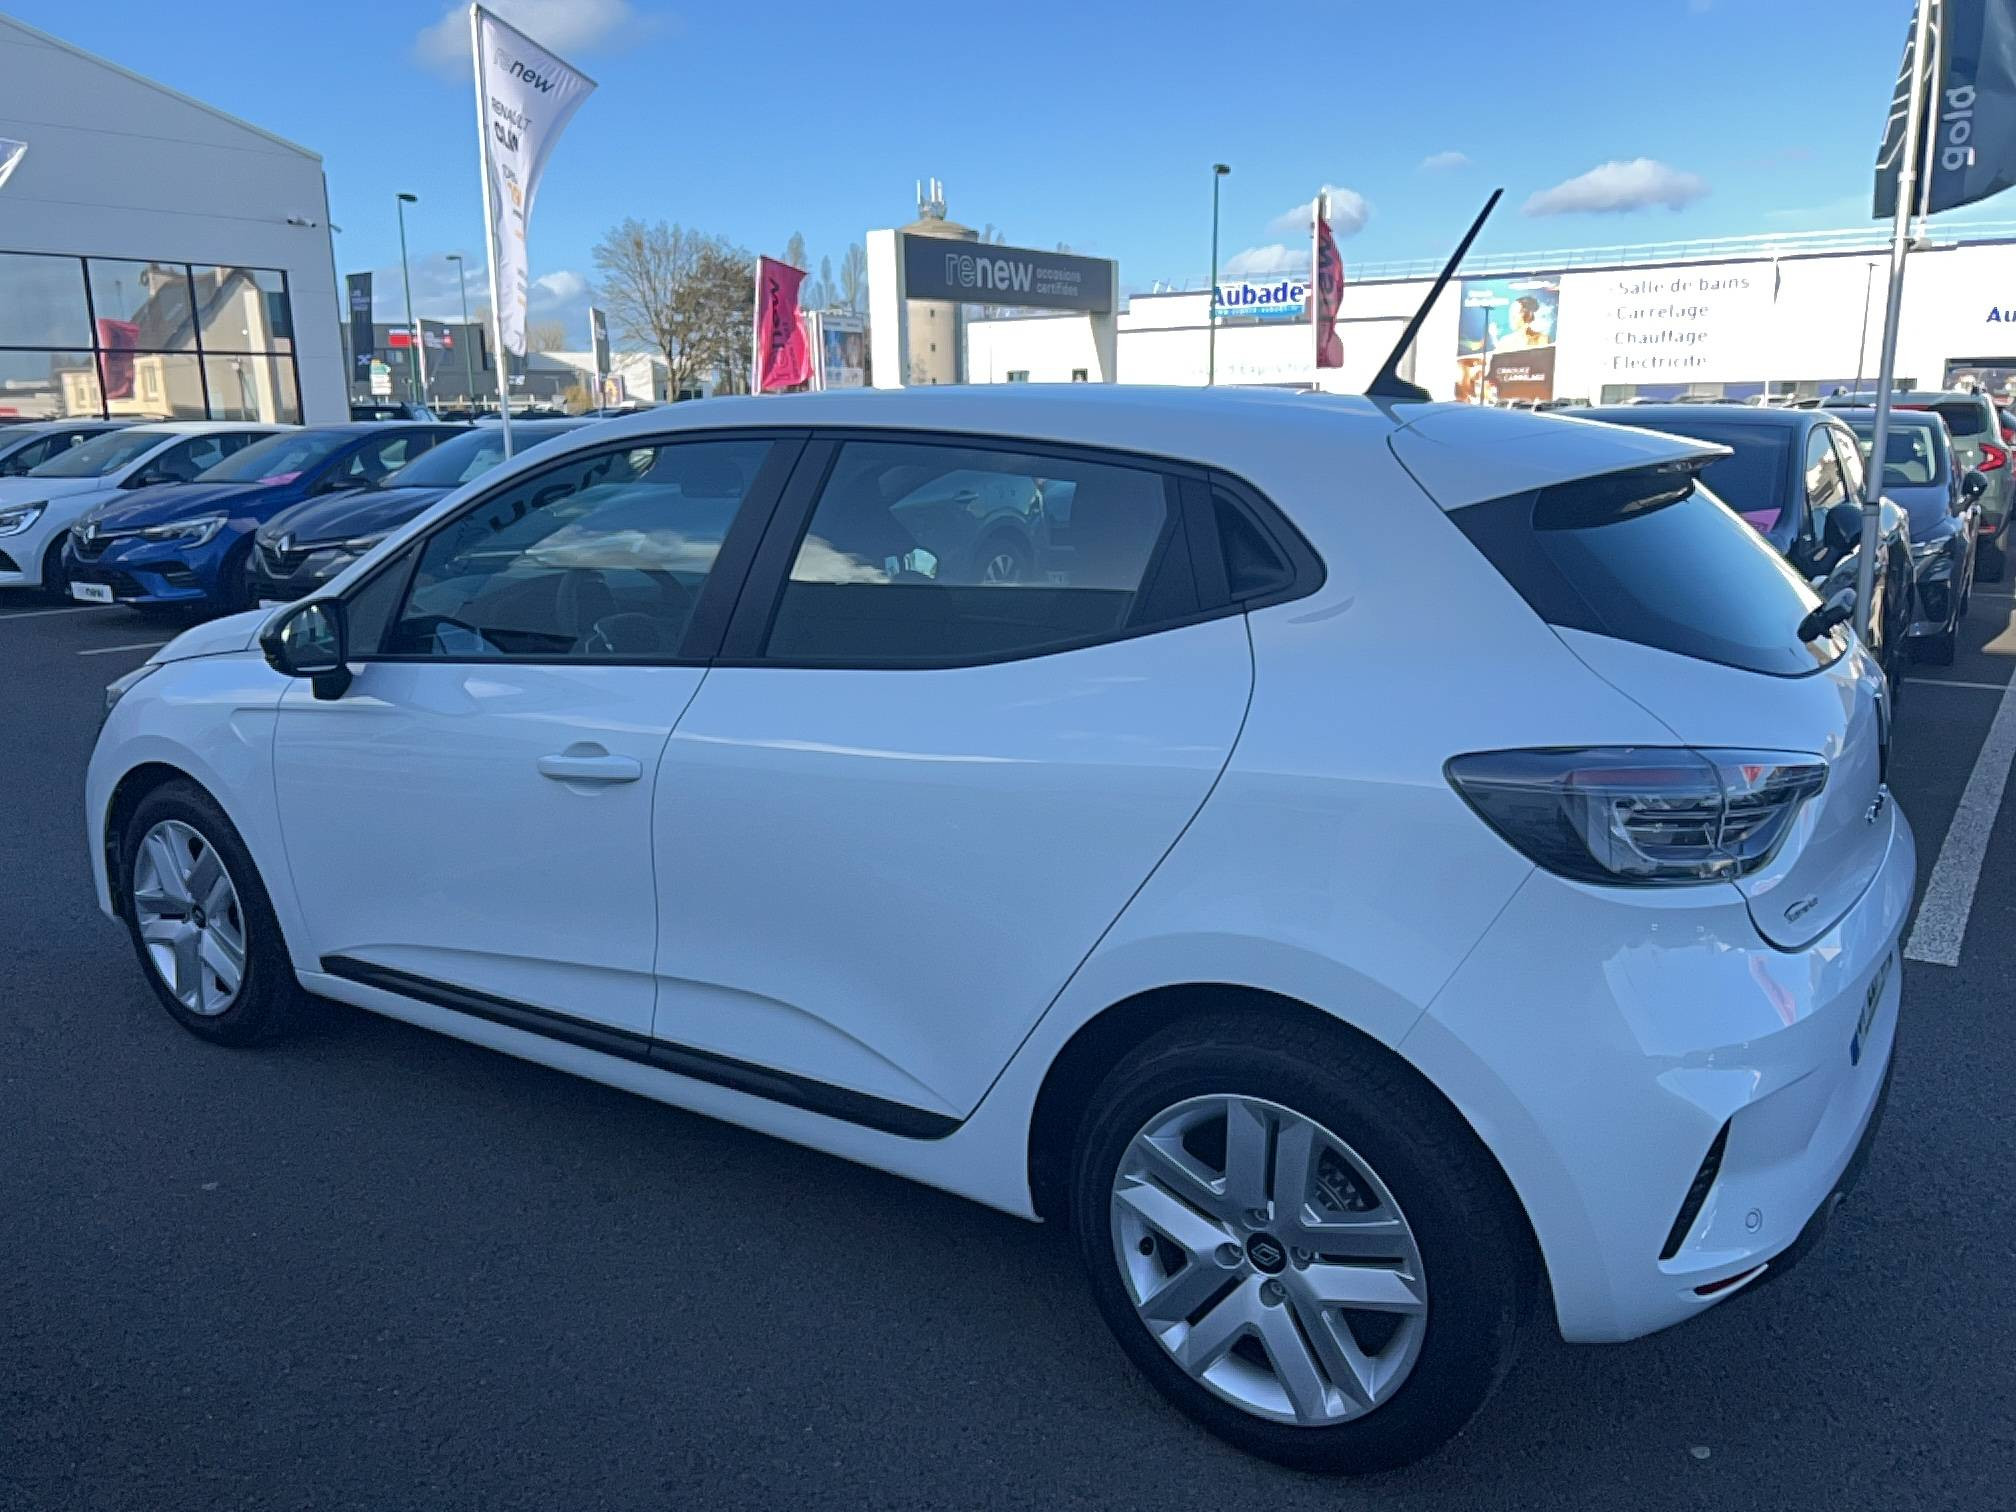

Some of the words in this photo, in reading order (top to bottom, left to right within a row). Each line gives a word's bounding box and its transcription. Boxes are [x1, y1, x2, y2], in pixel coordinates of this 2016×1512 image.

[1941, 84, 1976, 171] gold
[945, 253, 1033, 292] renew
[1213, 282, 1304, 306] Aubade
[1699, 277, 1750, 291] bains
[1617, 304, 1709, 320] Carrelage
[1615, 330, 1708, 345] Chauffage
